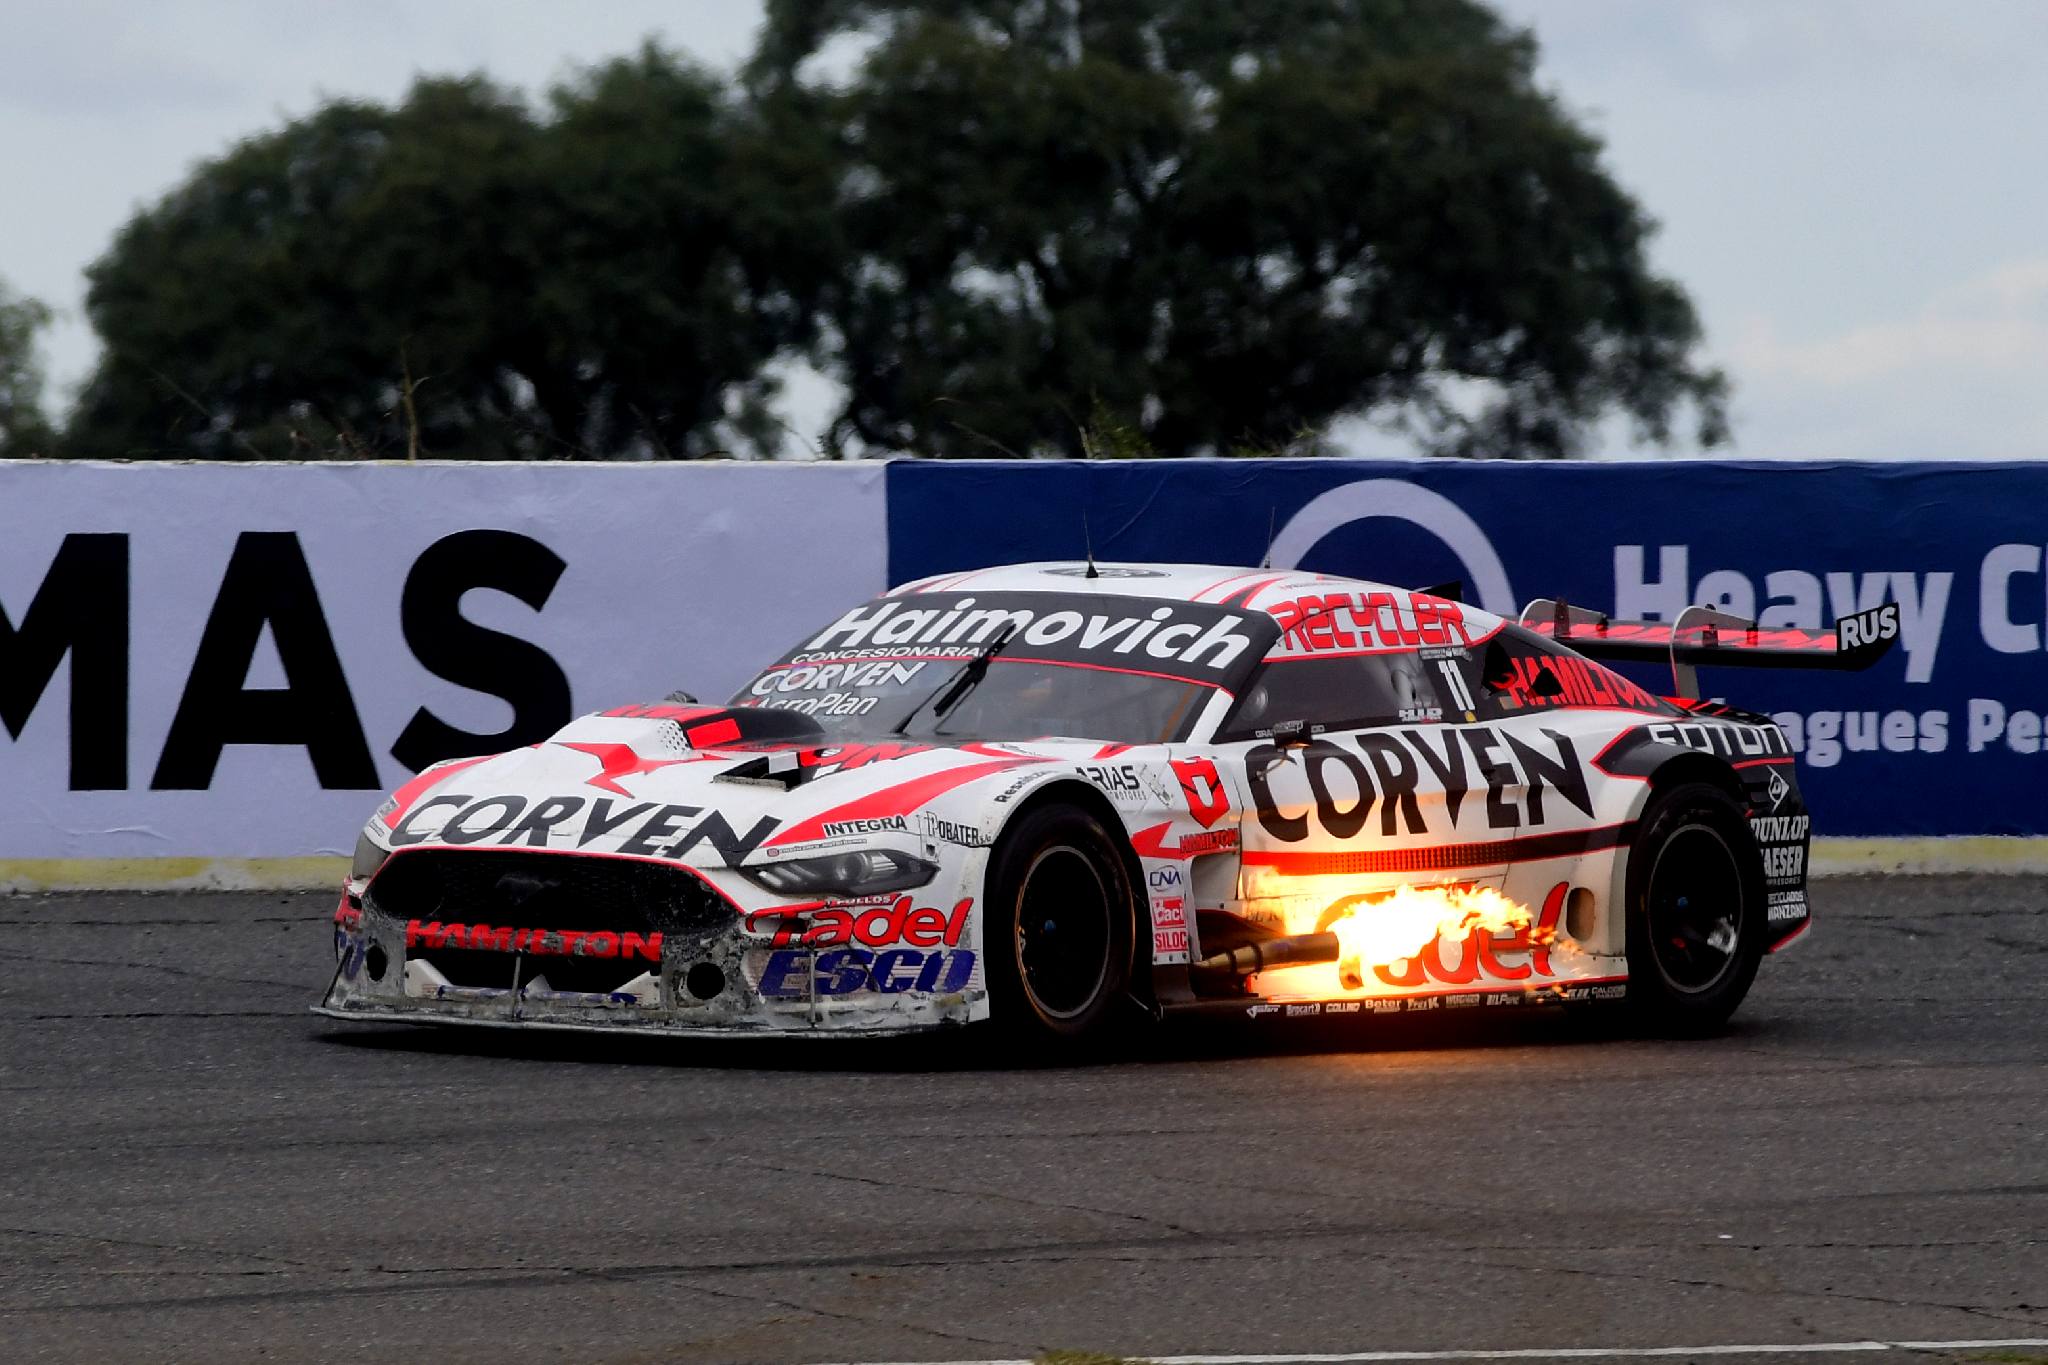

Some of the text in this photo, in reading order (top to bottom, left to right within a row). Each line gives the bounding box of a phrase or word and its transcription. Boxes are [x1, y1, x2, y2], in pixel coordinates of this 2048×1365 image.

[804, 597, 1250, 672] Haimovich
[1266, 592, 1471, 652] RECYCLER
[1614, 543, 2048, 683] Heavy C
[1841, 606, 1897, 650] RUS
[751, 660, 928, 697] CORVEN
[1437, 659, 1476, 711] 11
[1770, 698, 2048, 768] agues Pe
[1242, 726, 1596, 842] CORVEN
[389, 795, 782, 868] CORVEN
[823, 815, 909, 837] INTEGRA
[1750, 815, 1810, 842] DUNLOP
[1760, 846, 1804, 877] AESER
[406, 919, 663, 962] HAMILTON
[1155, 931, 1188, 949] SILOC
